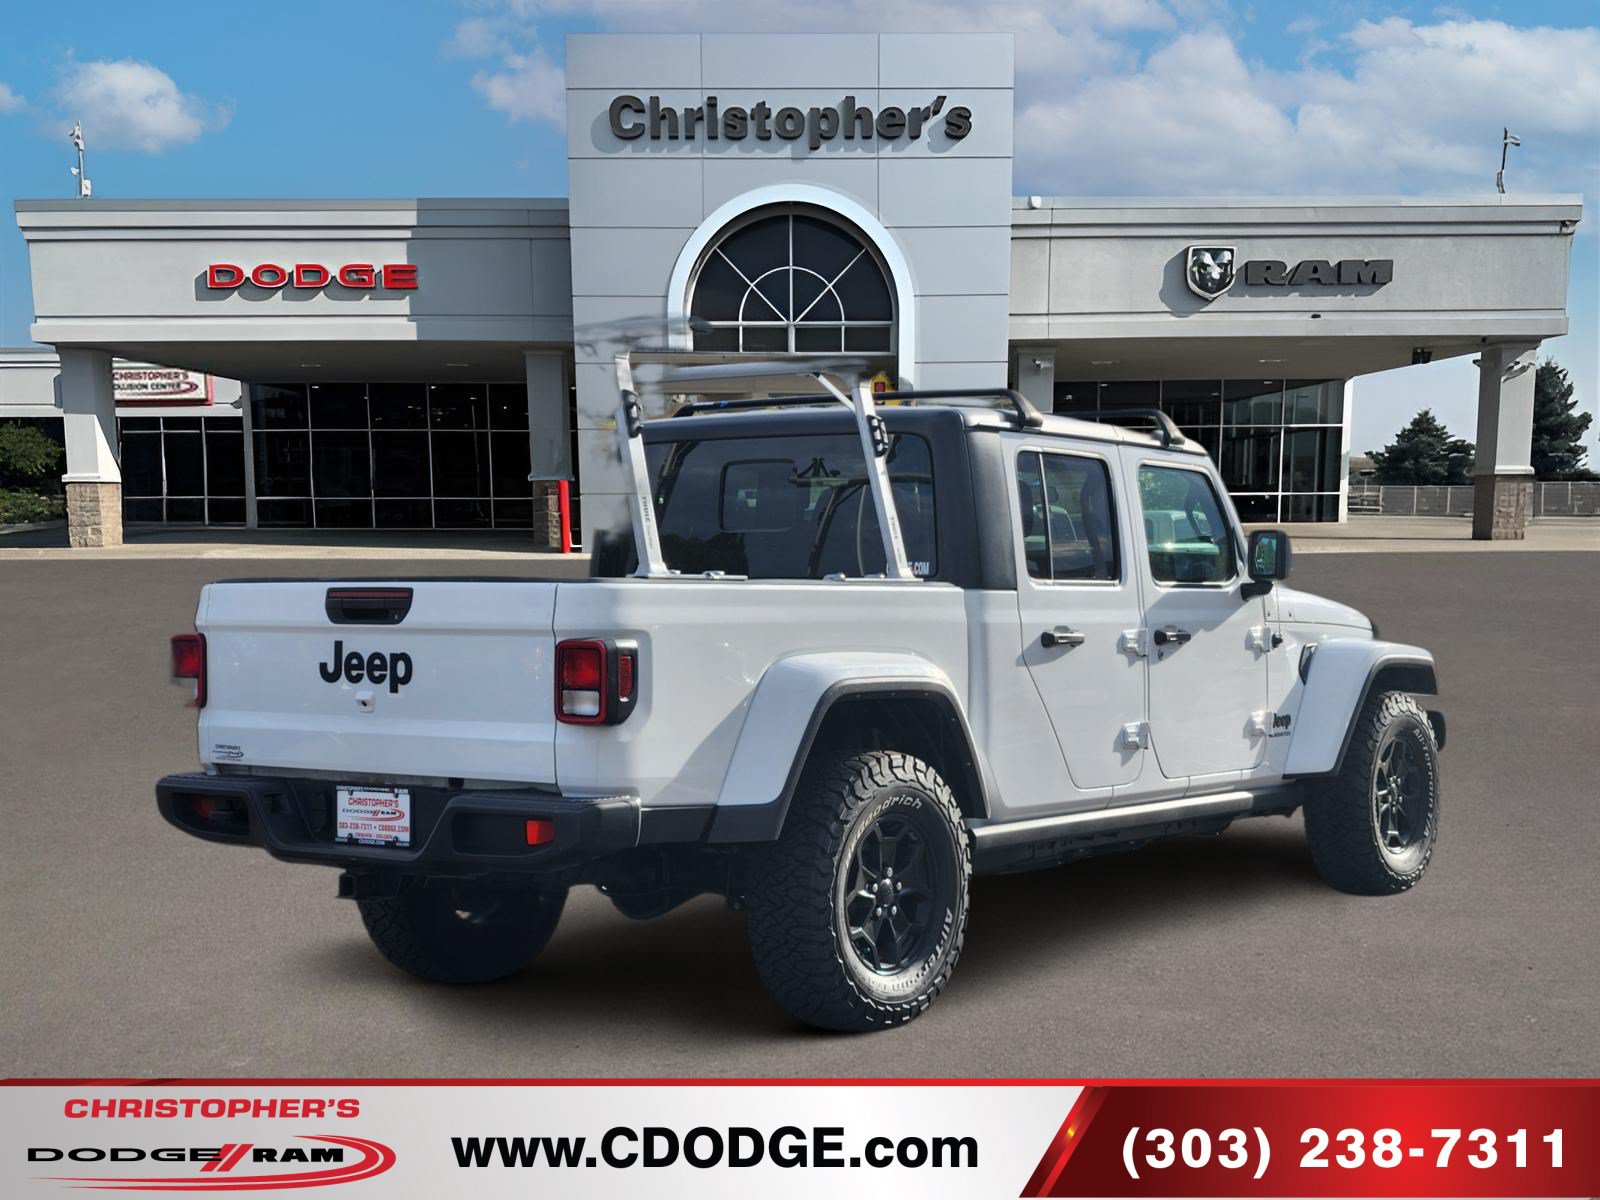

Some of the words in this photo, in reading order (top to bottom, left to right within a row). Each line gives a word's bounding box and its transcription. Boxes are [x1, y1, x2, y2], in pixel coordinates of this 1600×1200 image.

[608, 94, 973, 150] Christopher's
[207, 263, 418, 289] DODGE
[1245, 259, 1394, 286] RAM
[112, 382, 149, 391] OLLISION
[150, 382, 181, 391] CENTER
[319, 640, 413, 693] Jeep
[1273, 712, 1291, 730] Jeep
[347, 797, 400, 808] CHRISTOPHER'S
